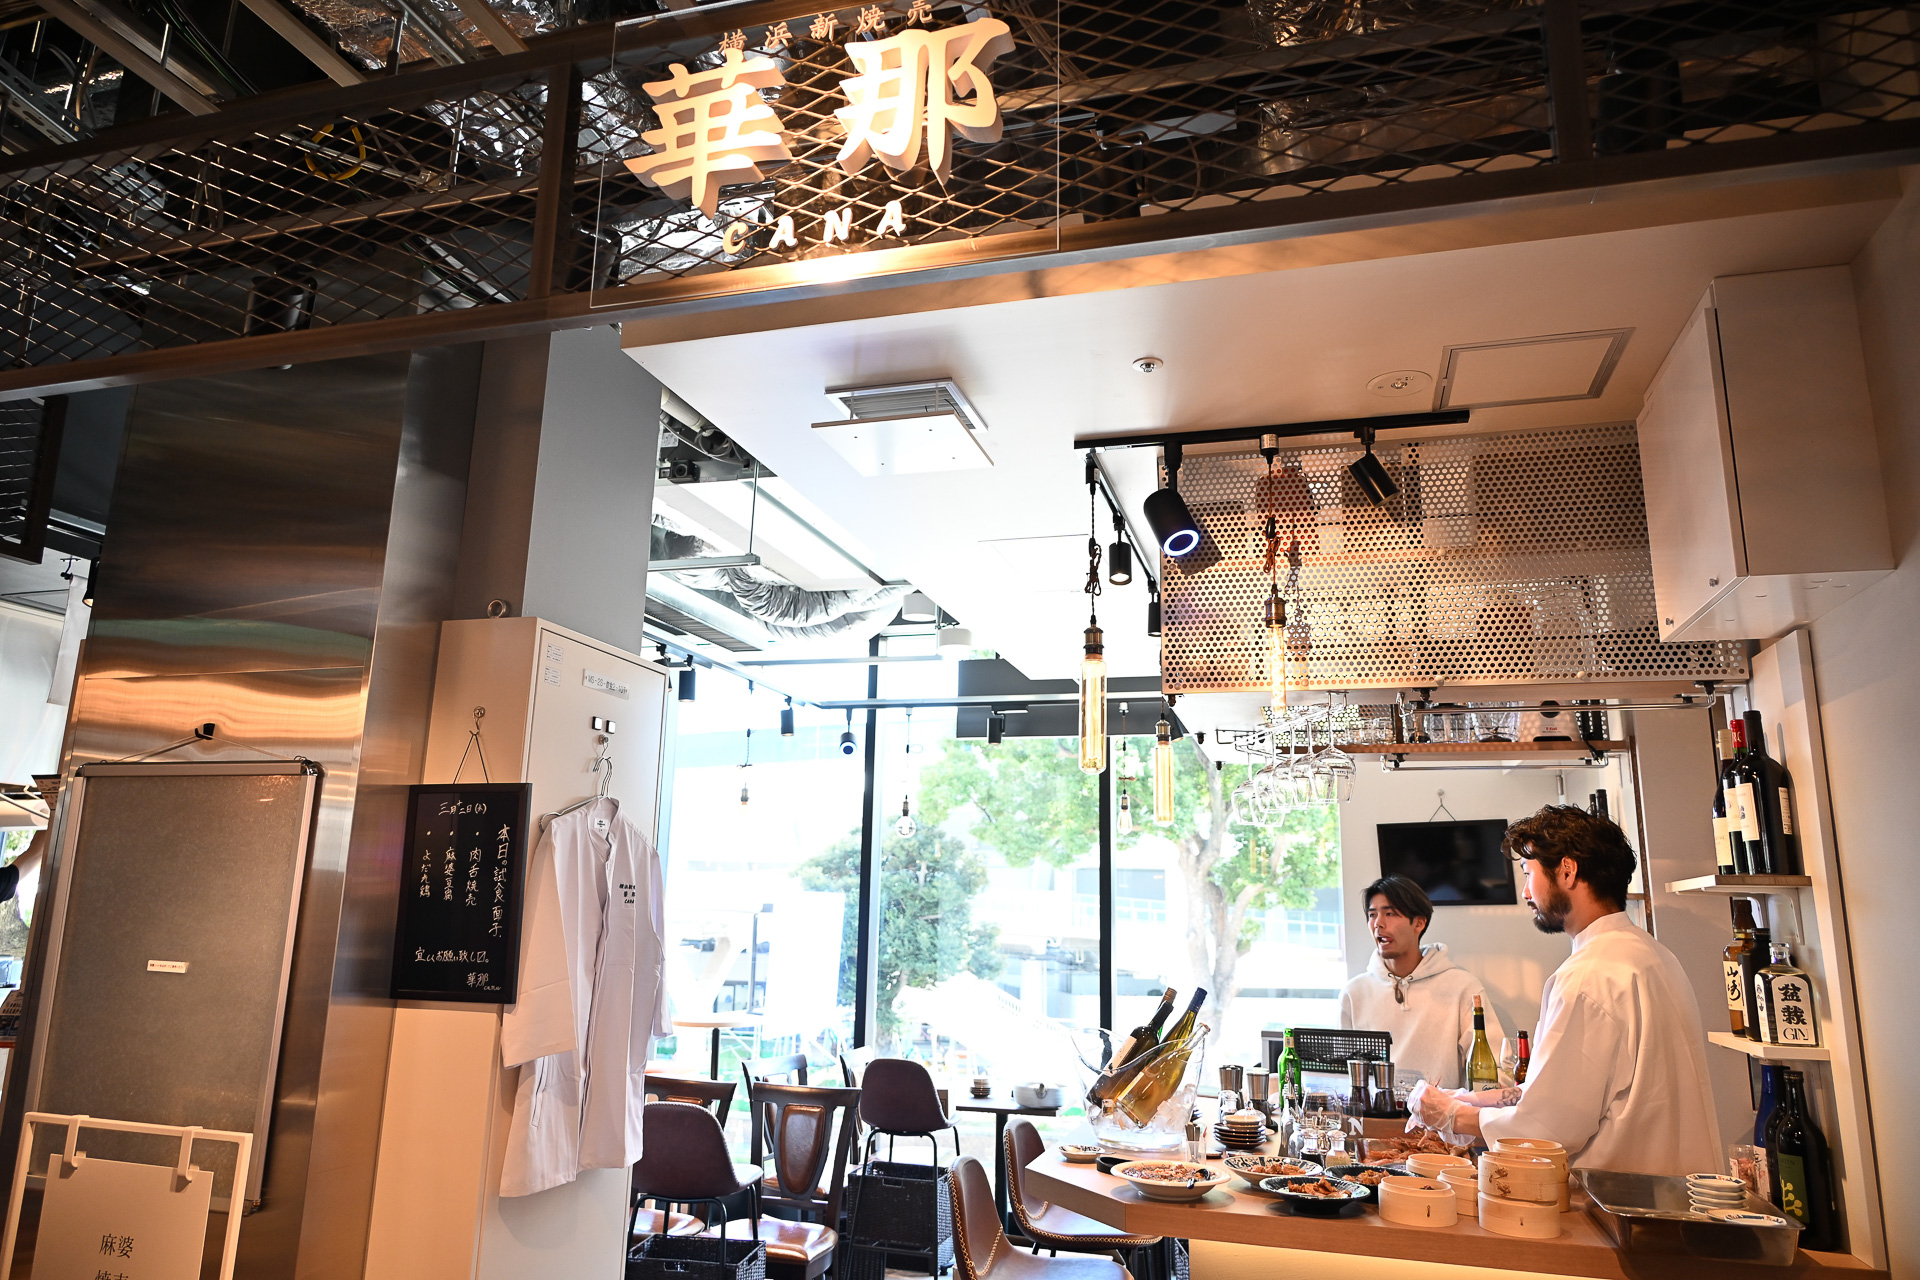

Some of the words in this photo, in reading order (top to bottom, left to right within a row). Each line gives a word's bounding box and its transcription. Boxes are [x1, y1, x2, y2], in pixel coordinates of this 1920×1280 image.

[718, 0, 934, 55] 横浜新焼売
[623, 17, 1016, 220] 華那
[721, 199, 907, 255] CANA
[1778, 983, 1807, 1026] 盆栽
[1783, 1027, 1809, 1041] GIN
[99, 1233, 135, 1259] 麻婆
